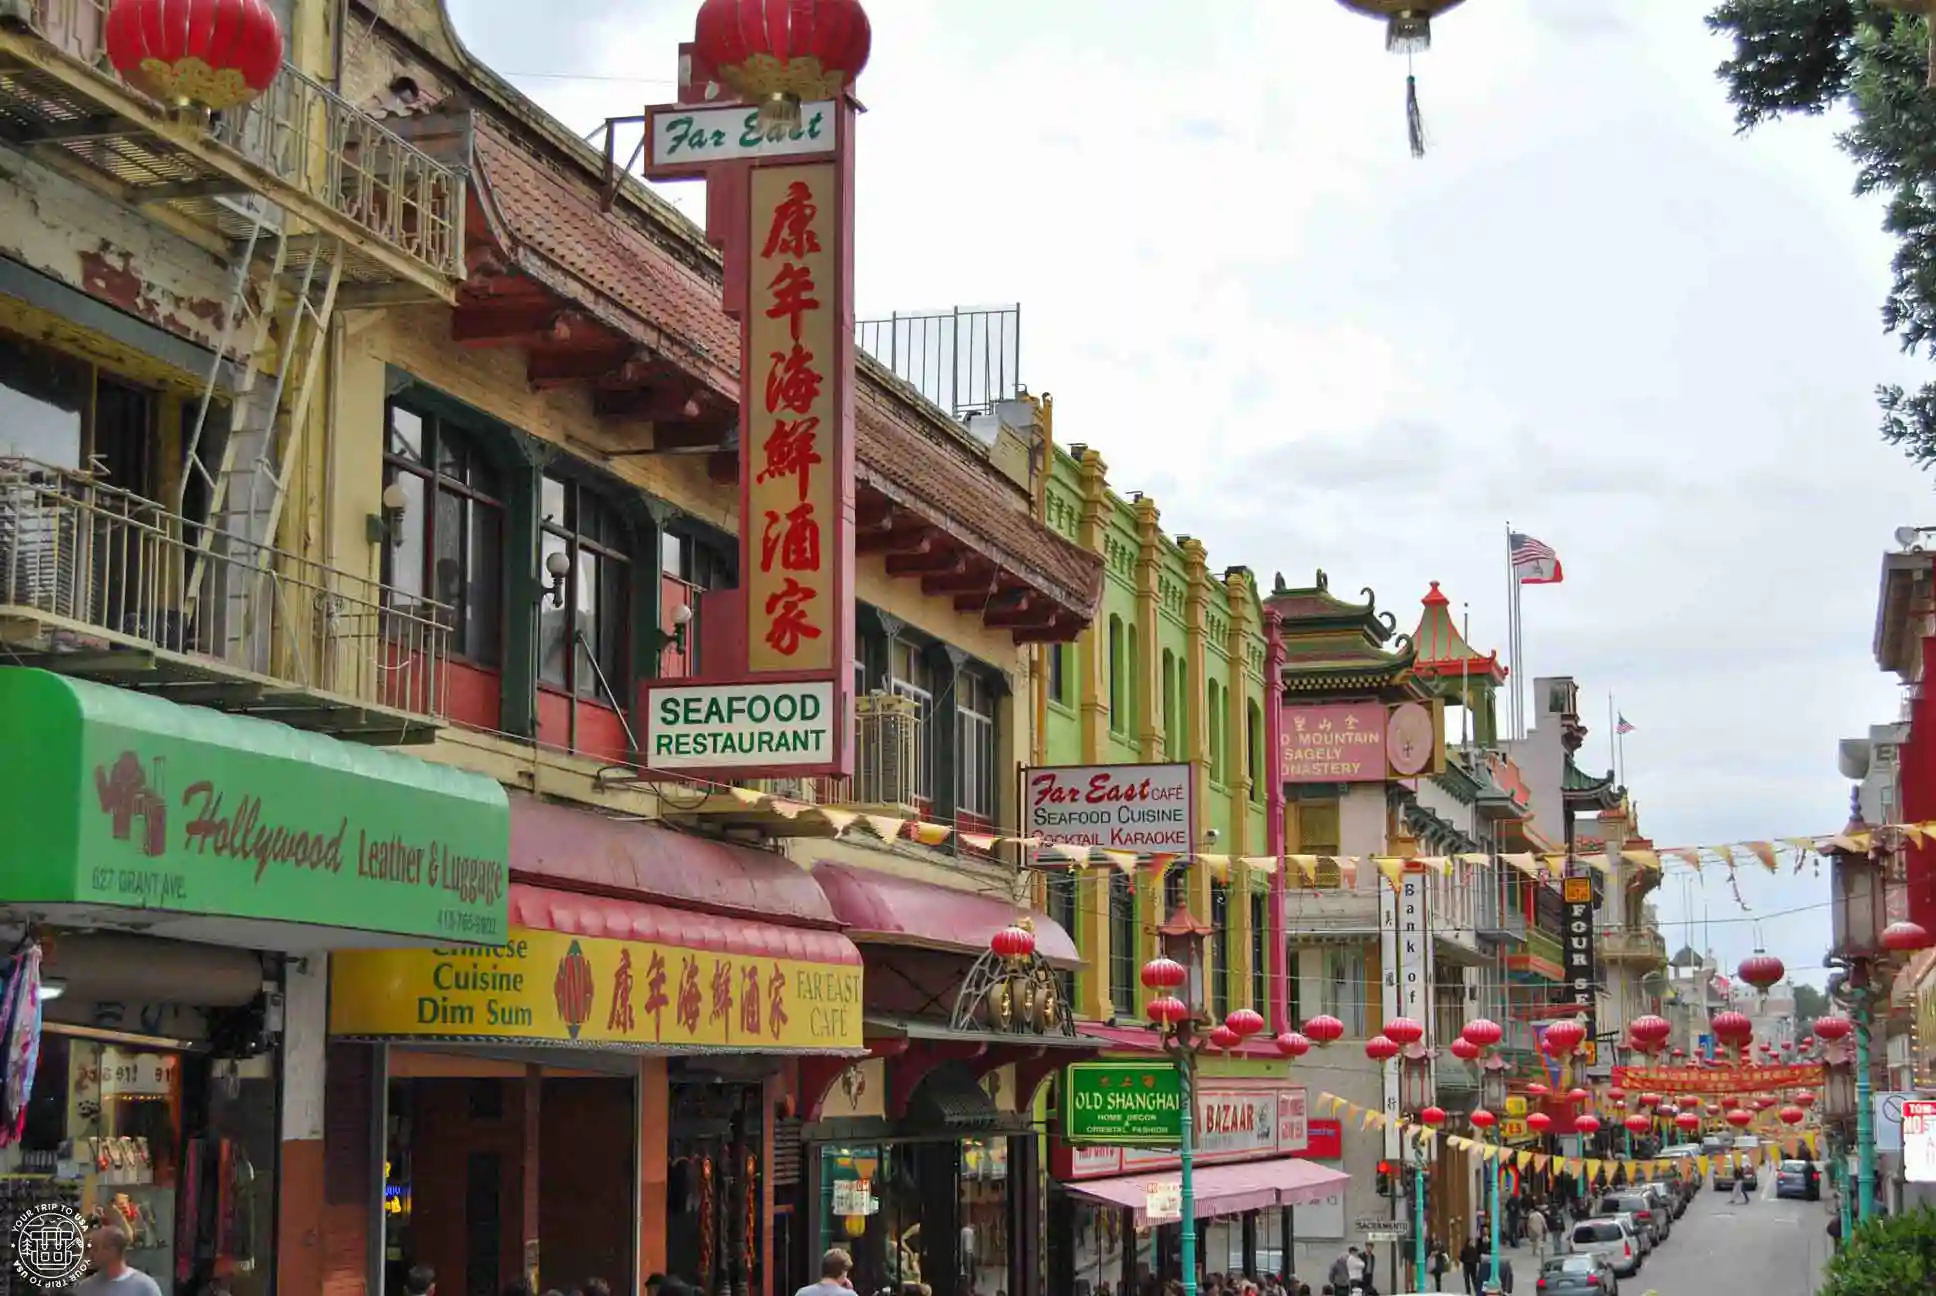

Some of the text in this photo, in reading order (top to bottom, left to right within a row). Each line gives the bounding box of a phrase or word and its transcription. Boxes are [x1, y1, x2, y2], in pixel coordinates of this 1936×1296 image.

[666, 116, 725, 155] Far
[756, 181, 823, 656] 康年海鮮酒家
[660, 694, 820, 725] SEAFOOD
[656, 729, 826, 755] RESTAURANT
[1300, 732, 1379, 745] MOUNTAIN
[1280, 761, 1361, 776] ONASTERY
[1284, 747, 1342, 761] SAGELY
[1031, 773, 1184, 806] Far East CAFÉ
[1034, 805, 1184, 825] SEAFOOD CUISINE
[183, 780, 502, 906] Hollywood Leather & Luggage
[1111, 828, 1185, 845] KARAOKE
[119, 870, 160, 895] GRANT
[1404, 884, 1416, 1004] Bank of
[1571, 905, 1588, 966] FOUR
[433, 962, 523, 992] Cuisine
[797, 970, 860, 1003] FAR EAST
[608, 949, 788, 1043] 康年海鮮酒家
[417, 997, 532, 1026] Dim Sum
[1075, 1091, 1180, 1111] OLD SHANGHAI
[1206, 1103, 1255, 1134] BAZAAR
